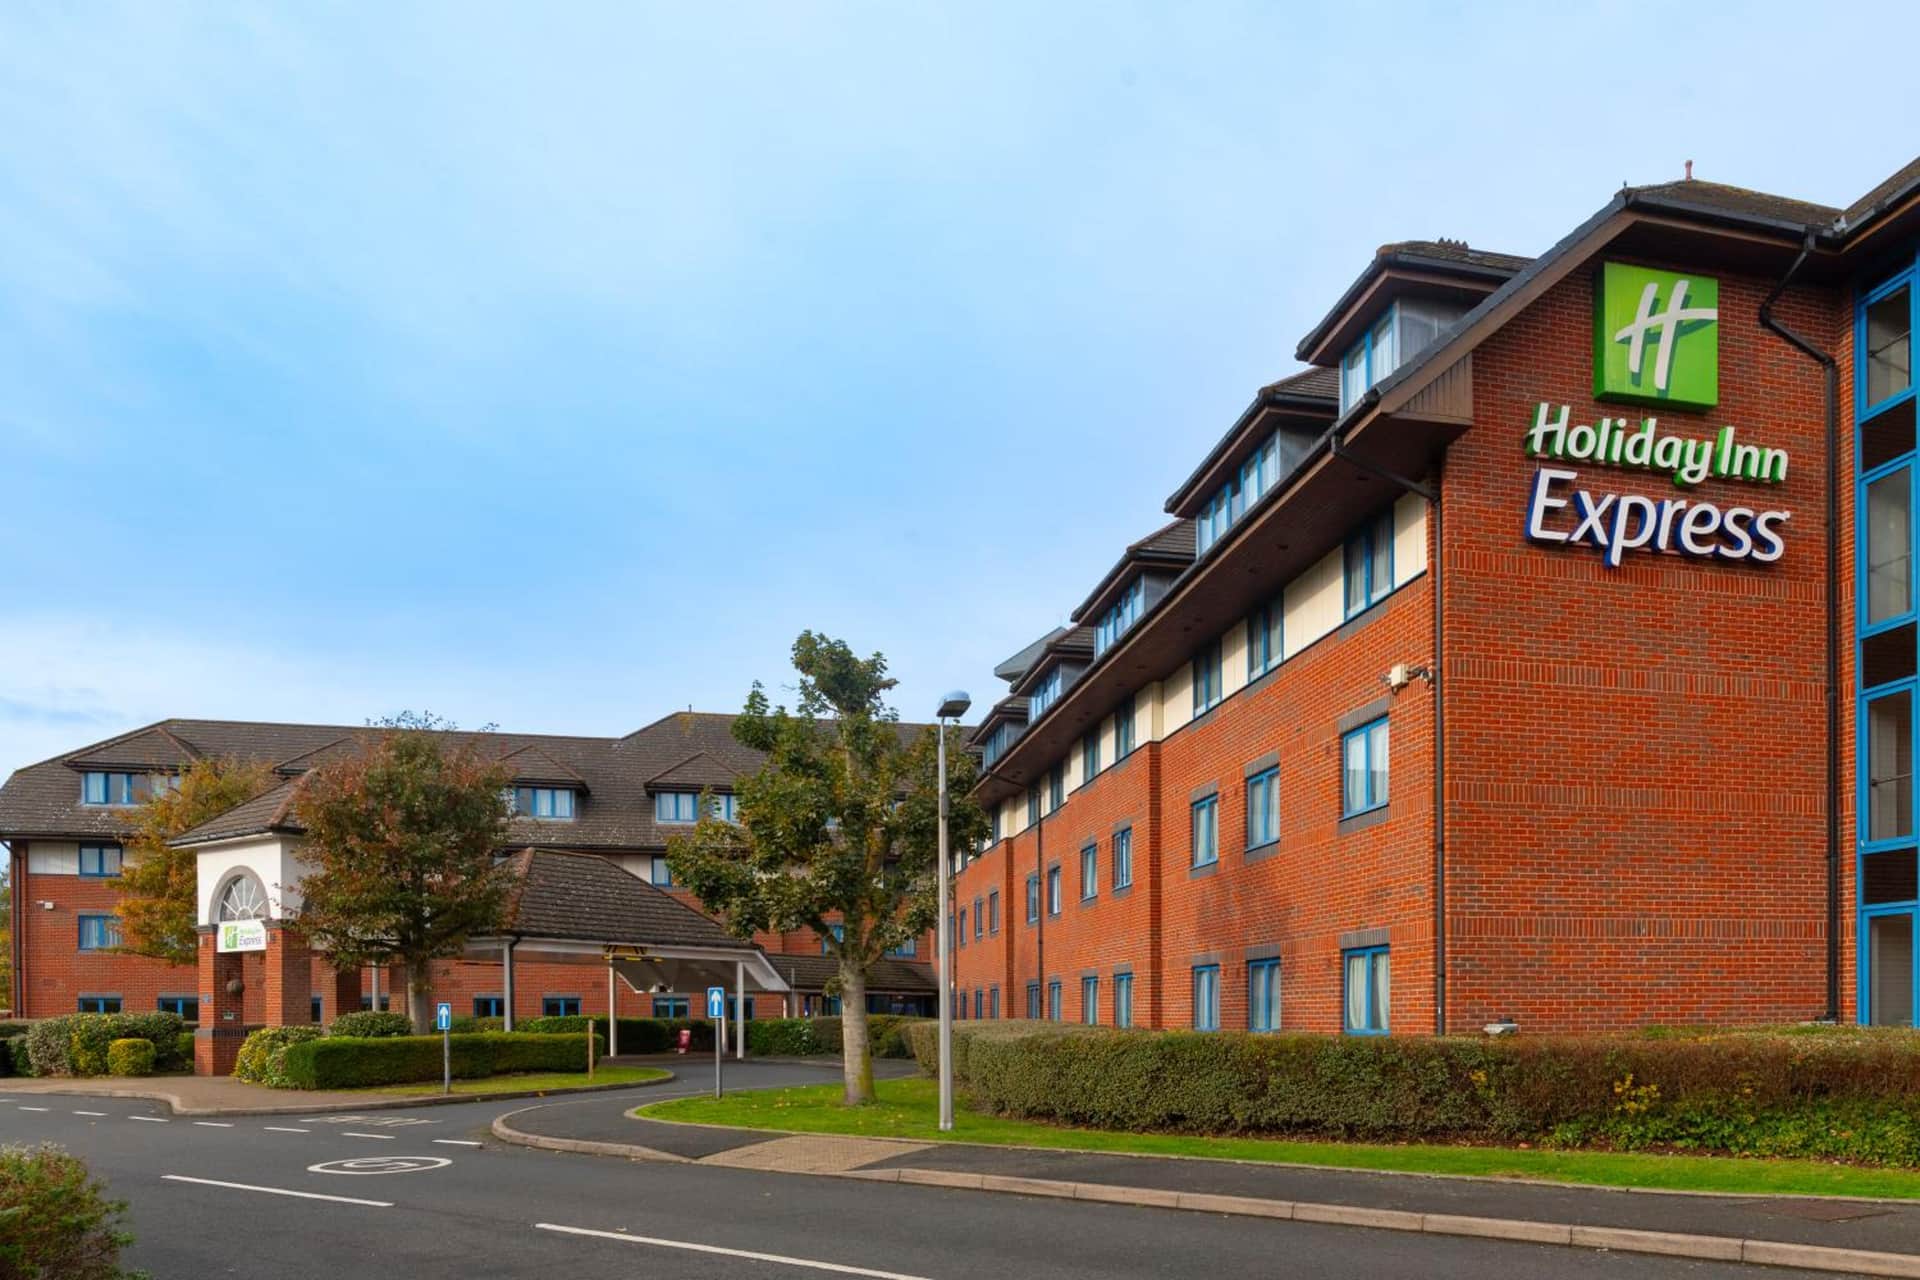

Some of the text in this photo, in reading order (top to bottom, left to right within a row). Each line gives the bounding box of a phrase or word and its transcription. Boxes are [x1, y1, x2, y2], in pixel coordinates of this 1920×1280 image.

[1526, 402, 1789, 485] Holiday Inn
[1526, 467, 1791, 569] Express
